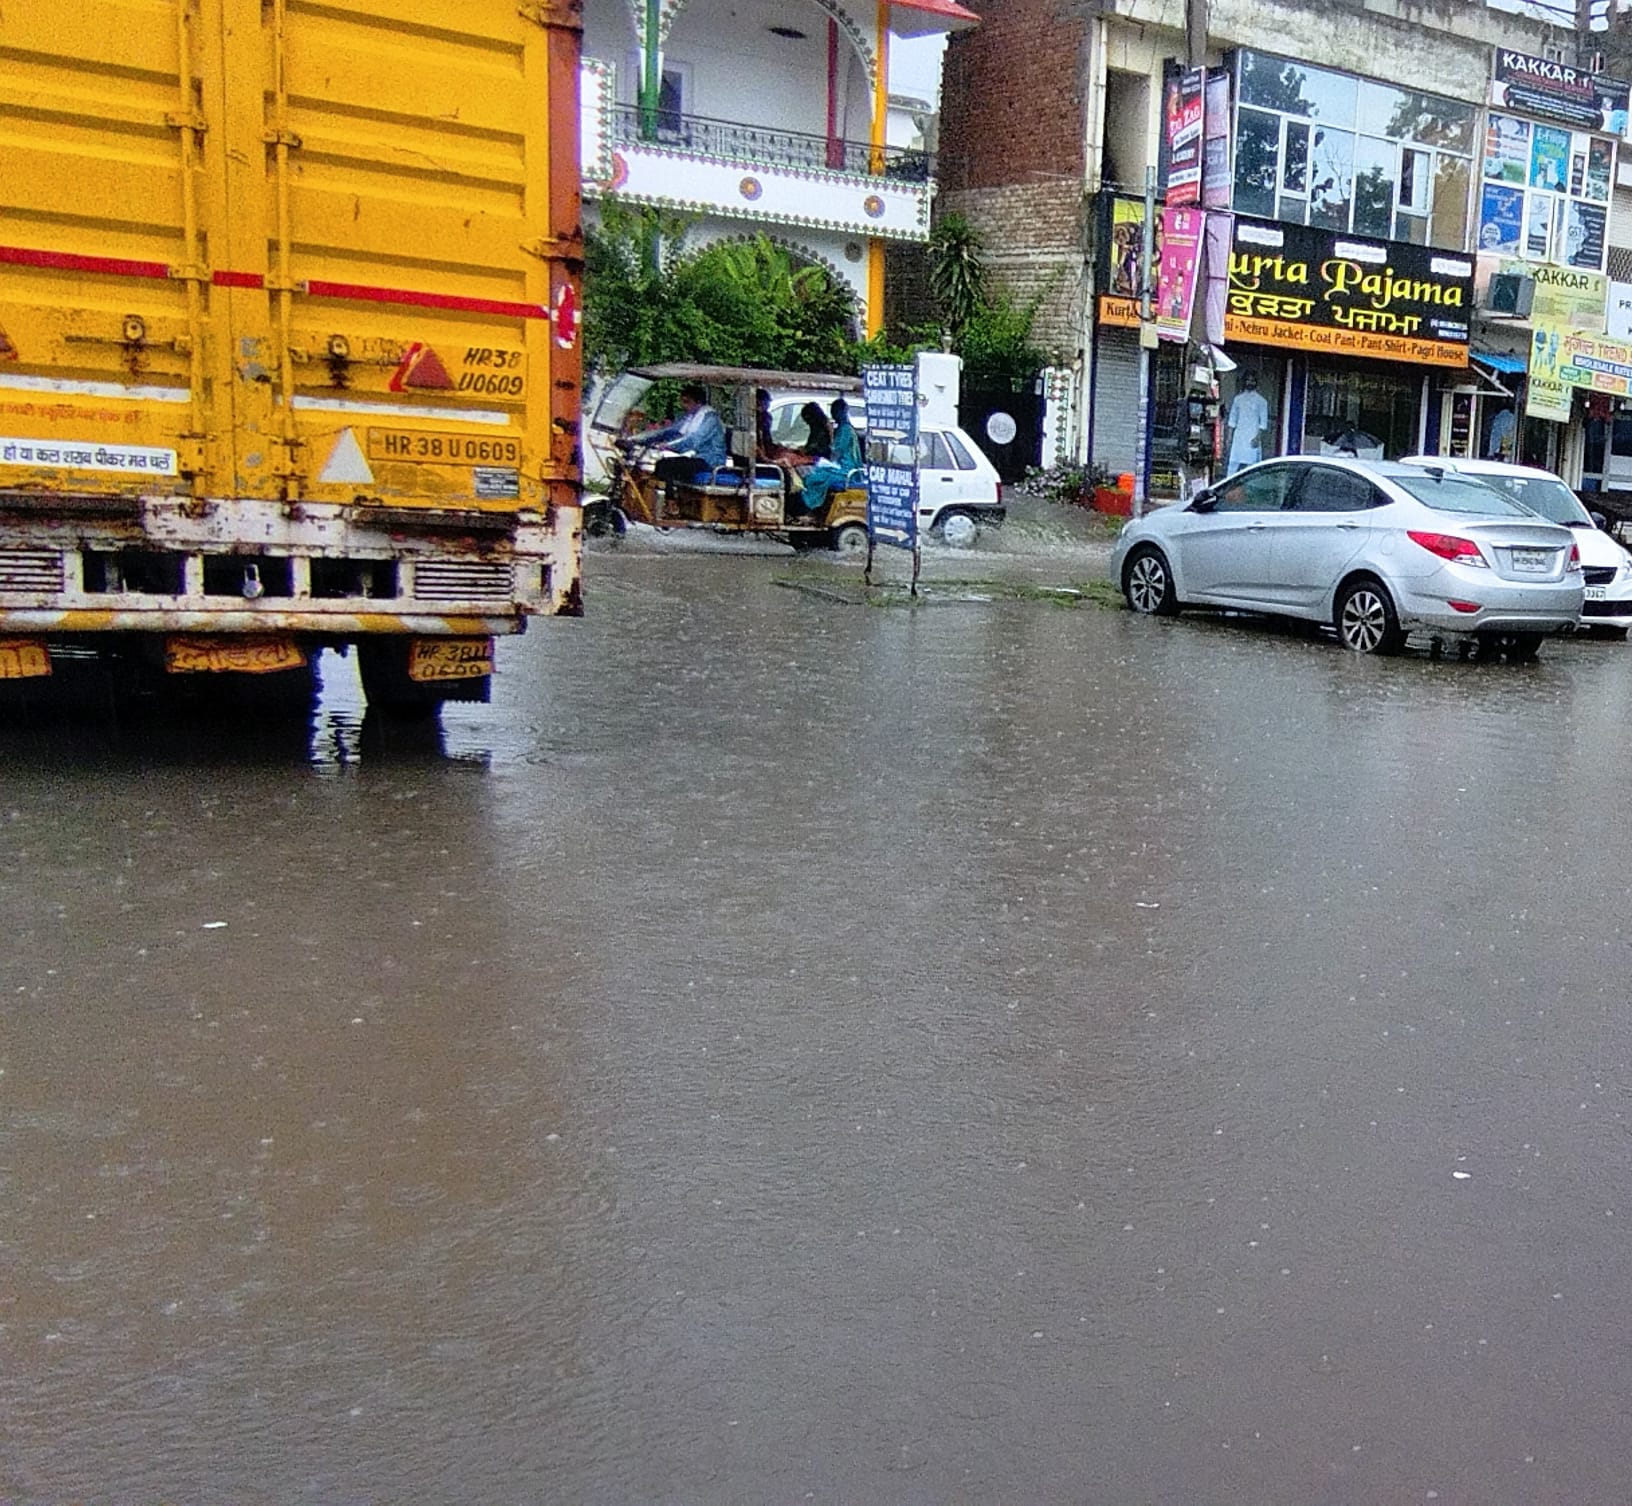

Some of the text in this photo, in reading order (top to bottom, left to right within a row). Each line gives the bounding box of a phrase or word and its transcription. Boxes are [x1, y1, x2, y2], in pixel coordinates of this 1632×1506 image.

[1502, 50, 1577, 85] KAKKAR
[1321, 258, 1464, 308] Pajama
[1532, 267, 1590, 290] KAKKAR
[1272, 326, 1304, 341] Jacket
[1411, 342, 1435, 360] Pagri
[463, 347, 522, 369] HR38
[458, 372, 524, 396] U0609
[866, 370, 887, 387] CEAT
[1532, 378, 1563, 393] KAKKAR
[384, 434, 517, 462] HR 38 U 0609
[869, 465, 886, 483] CAR
